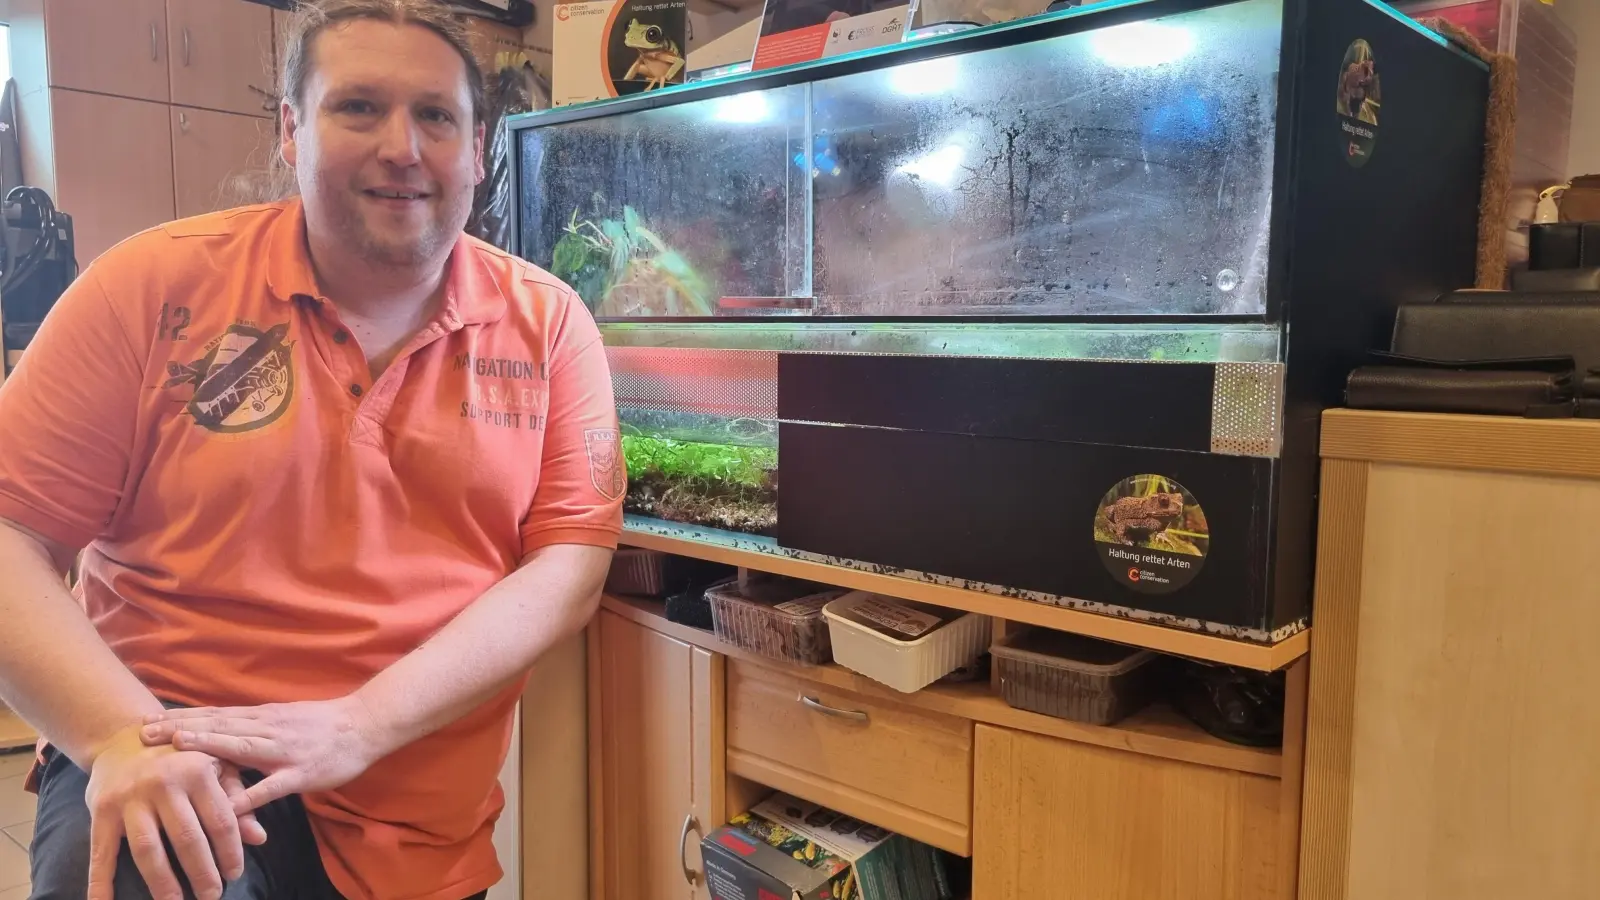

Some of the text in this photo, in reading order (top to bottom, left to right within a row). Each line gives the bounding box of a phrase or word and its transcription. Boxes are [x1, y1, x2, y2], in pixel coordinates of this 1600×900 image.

[453, 351, 533, 381] NAIGATION
[460, 399, 522, 429] SUPPORT
[1108, 548, 1191, 569] Haltung rettet Arten
[1140, 569, 1155, 577] citizen
[1140, 574, 1170, 584] conservation
